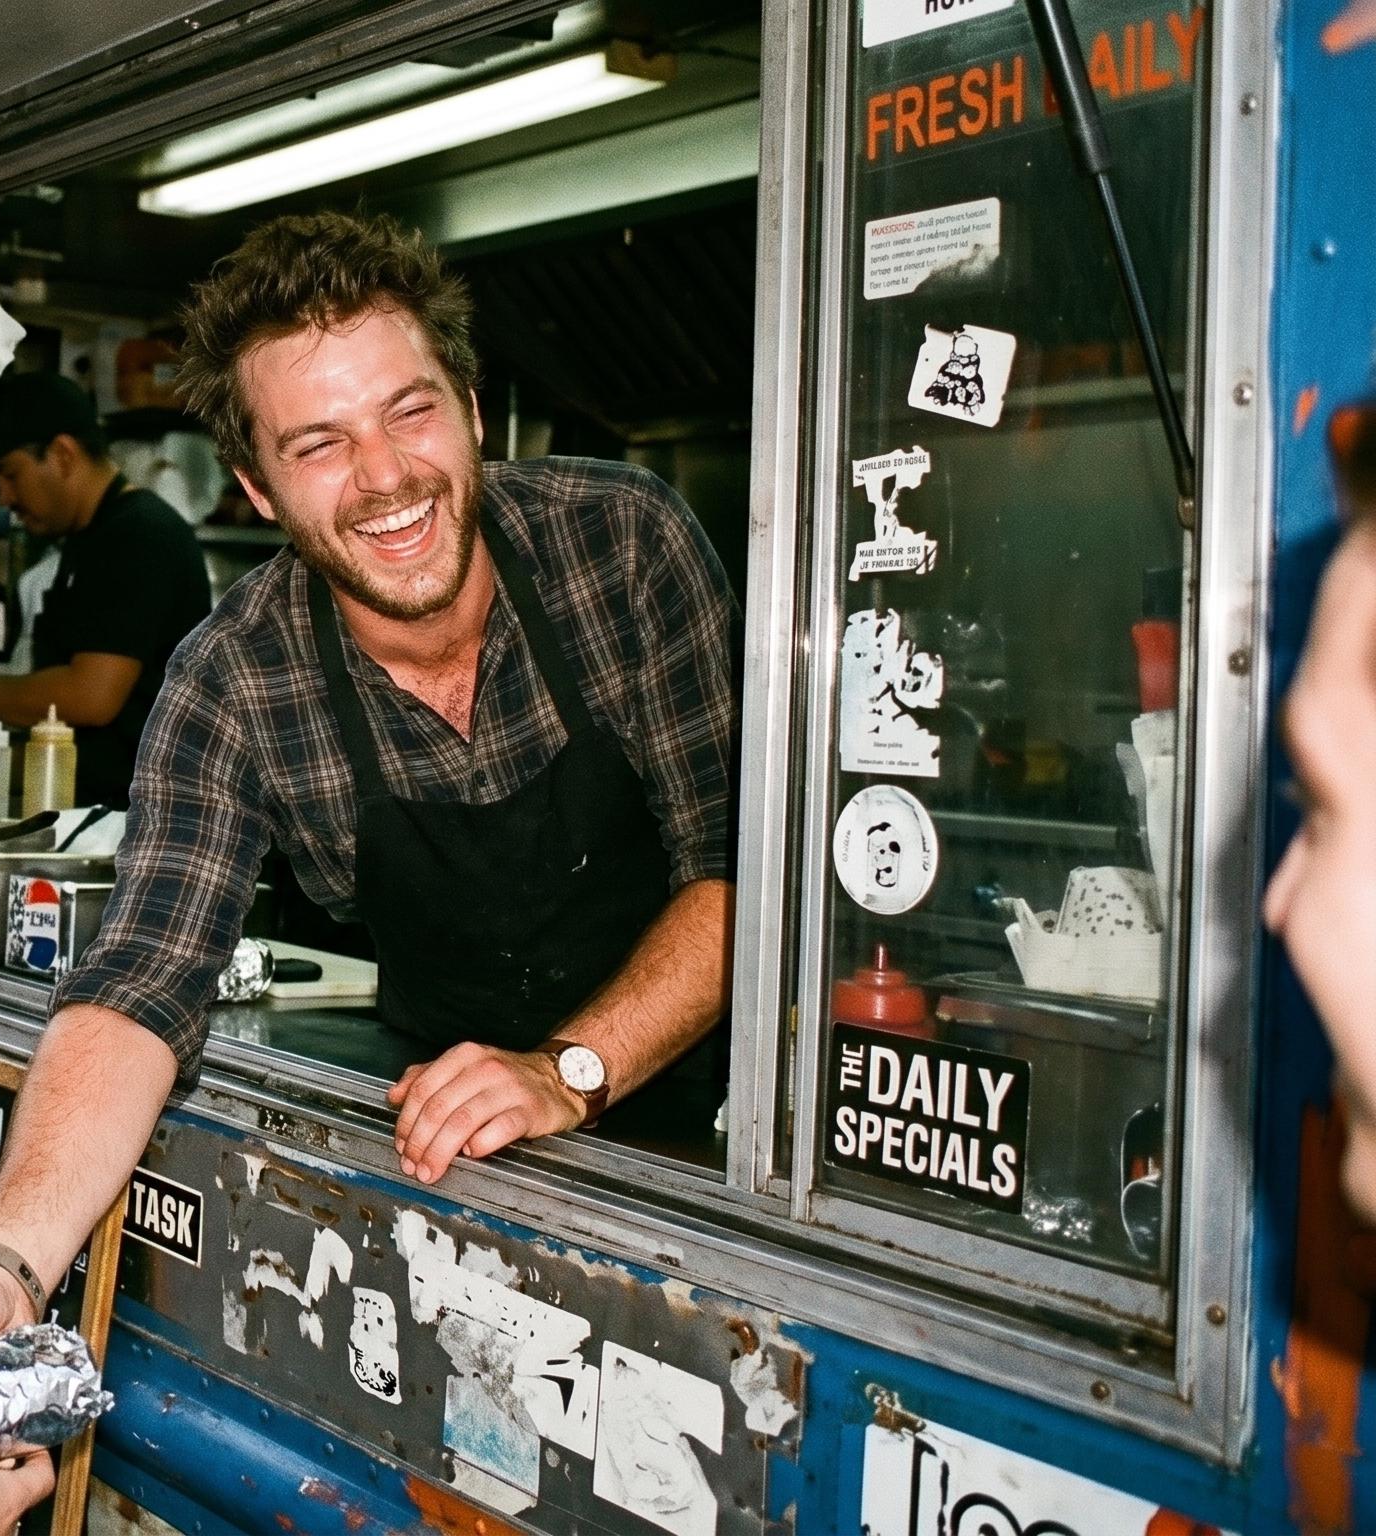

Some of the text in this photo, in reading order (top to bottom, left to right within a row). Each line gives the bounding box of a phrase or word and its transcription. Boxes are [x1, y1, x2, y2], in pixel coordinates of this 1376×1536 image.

[867, 54, 1023, 161] FRESH
[868, 1044, 1015, 1132] DAILY
[834, 1105, 1017, 1198] SPECIALS
[125, 1180, 195, 1248] TASK
